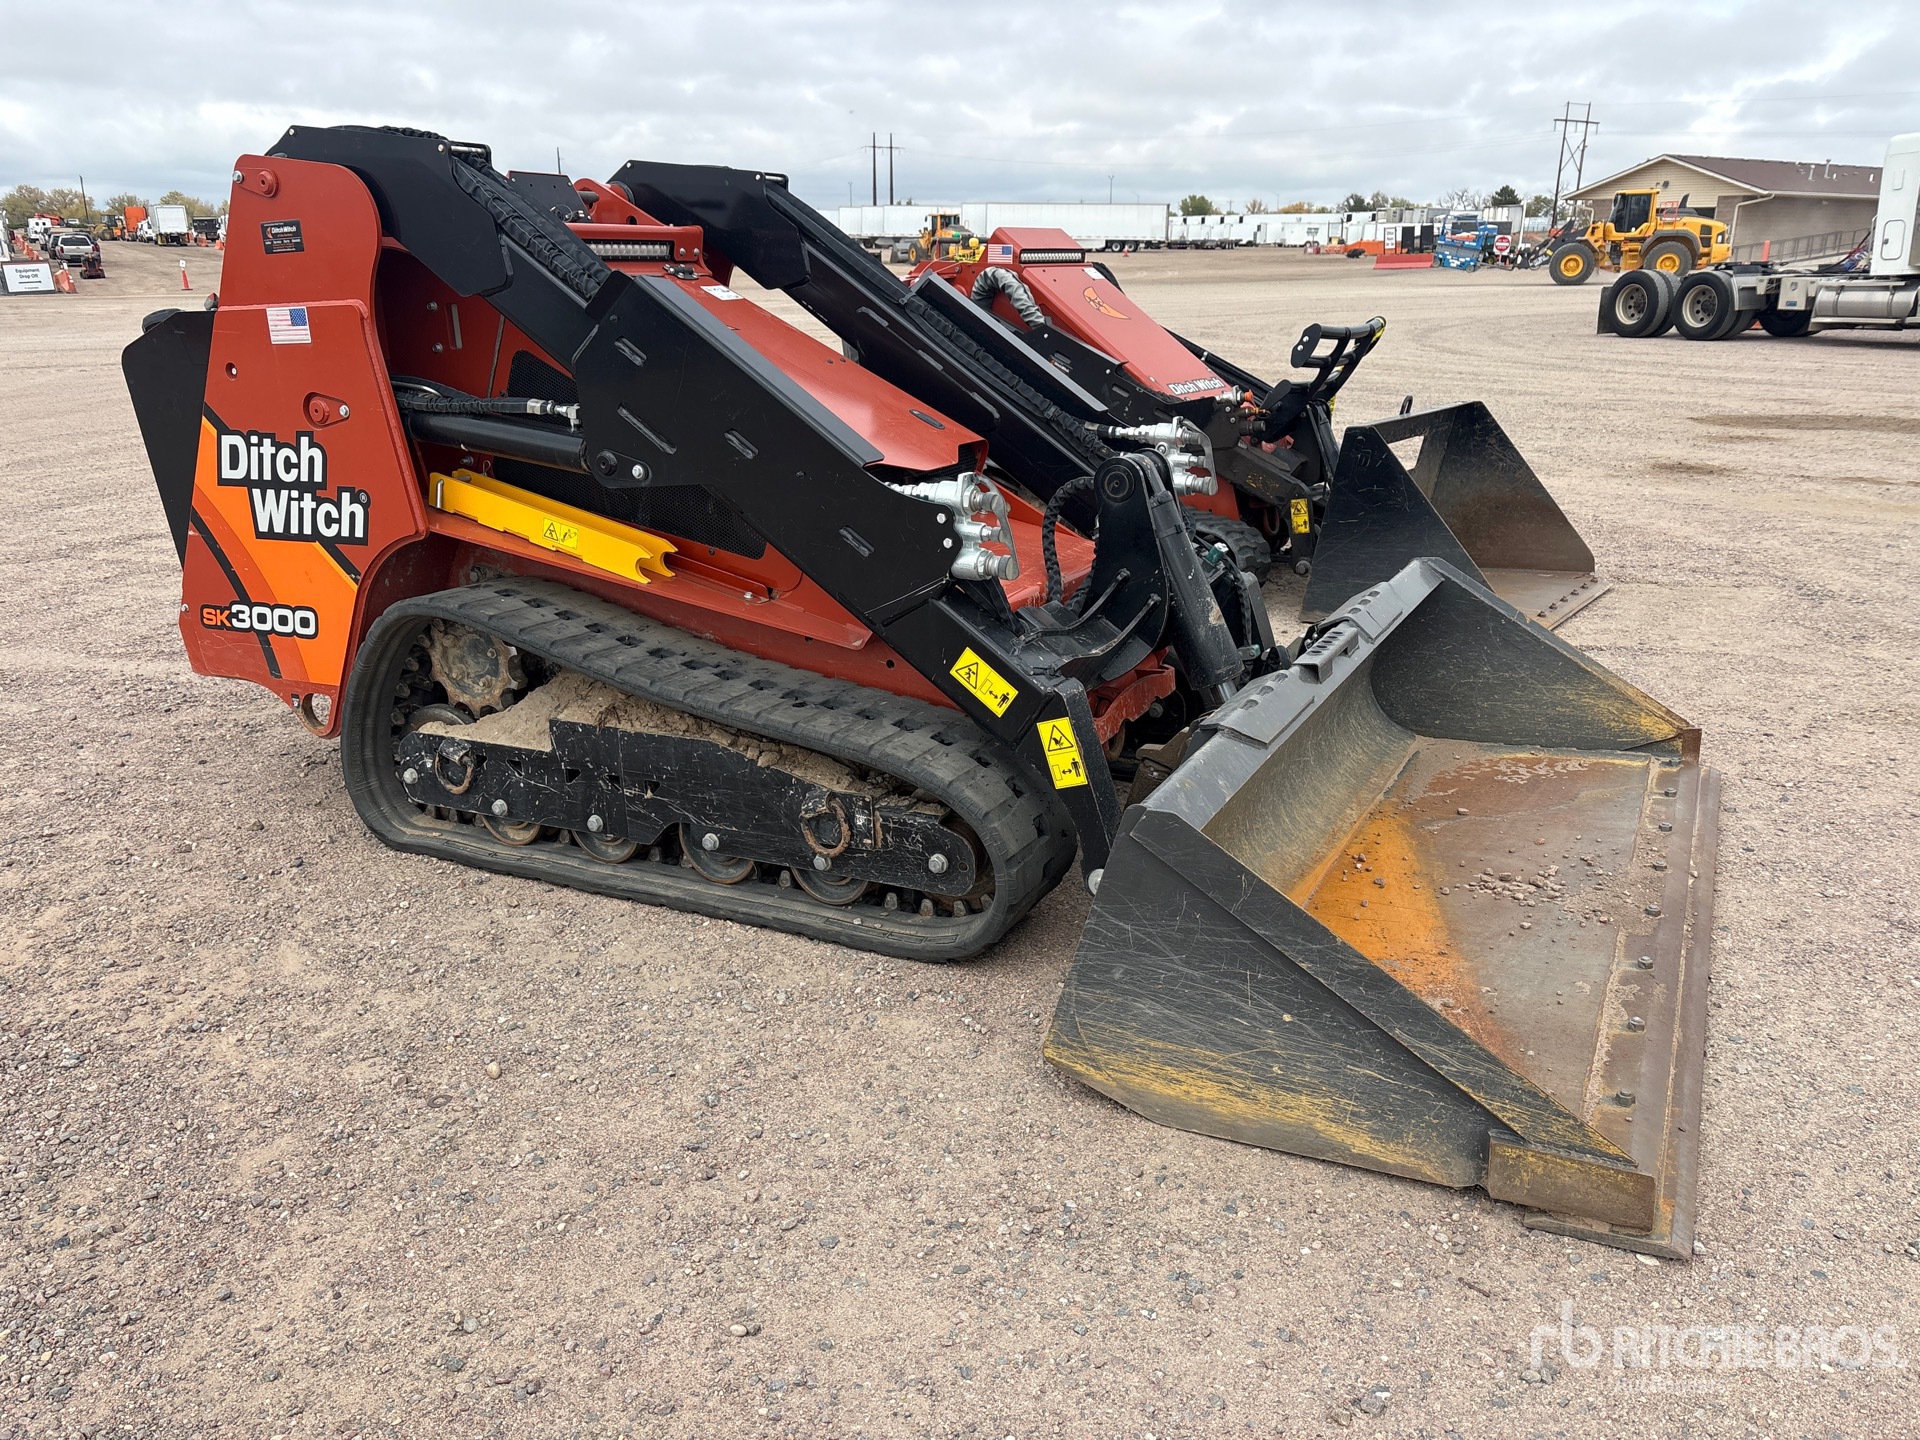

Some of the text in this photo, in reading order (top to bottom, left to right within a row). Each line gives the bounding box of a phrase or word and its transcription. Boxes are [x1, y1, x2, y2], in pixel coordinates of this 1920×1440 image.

[1168, 377, 1225, 395] Ditch Witch
[220, 434, 323, 483] Ditch
[202, 603, 316, 636] SK3000
